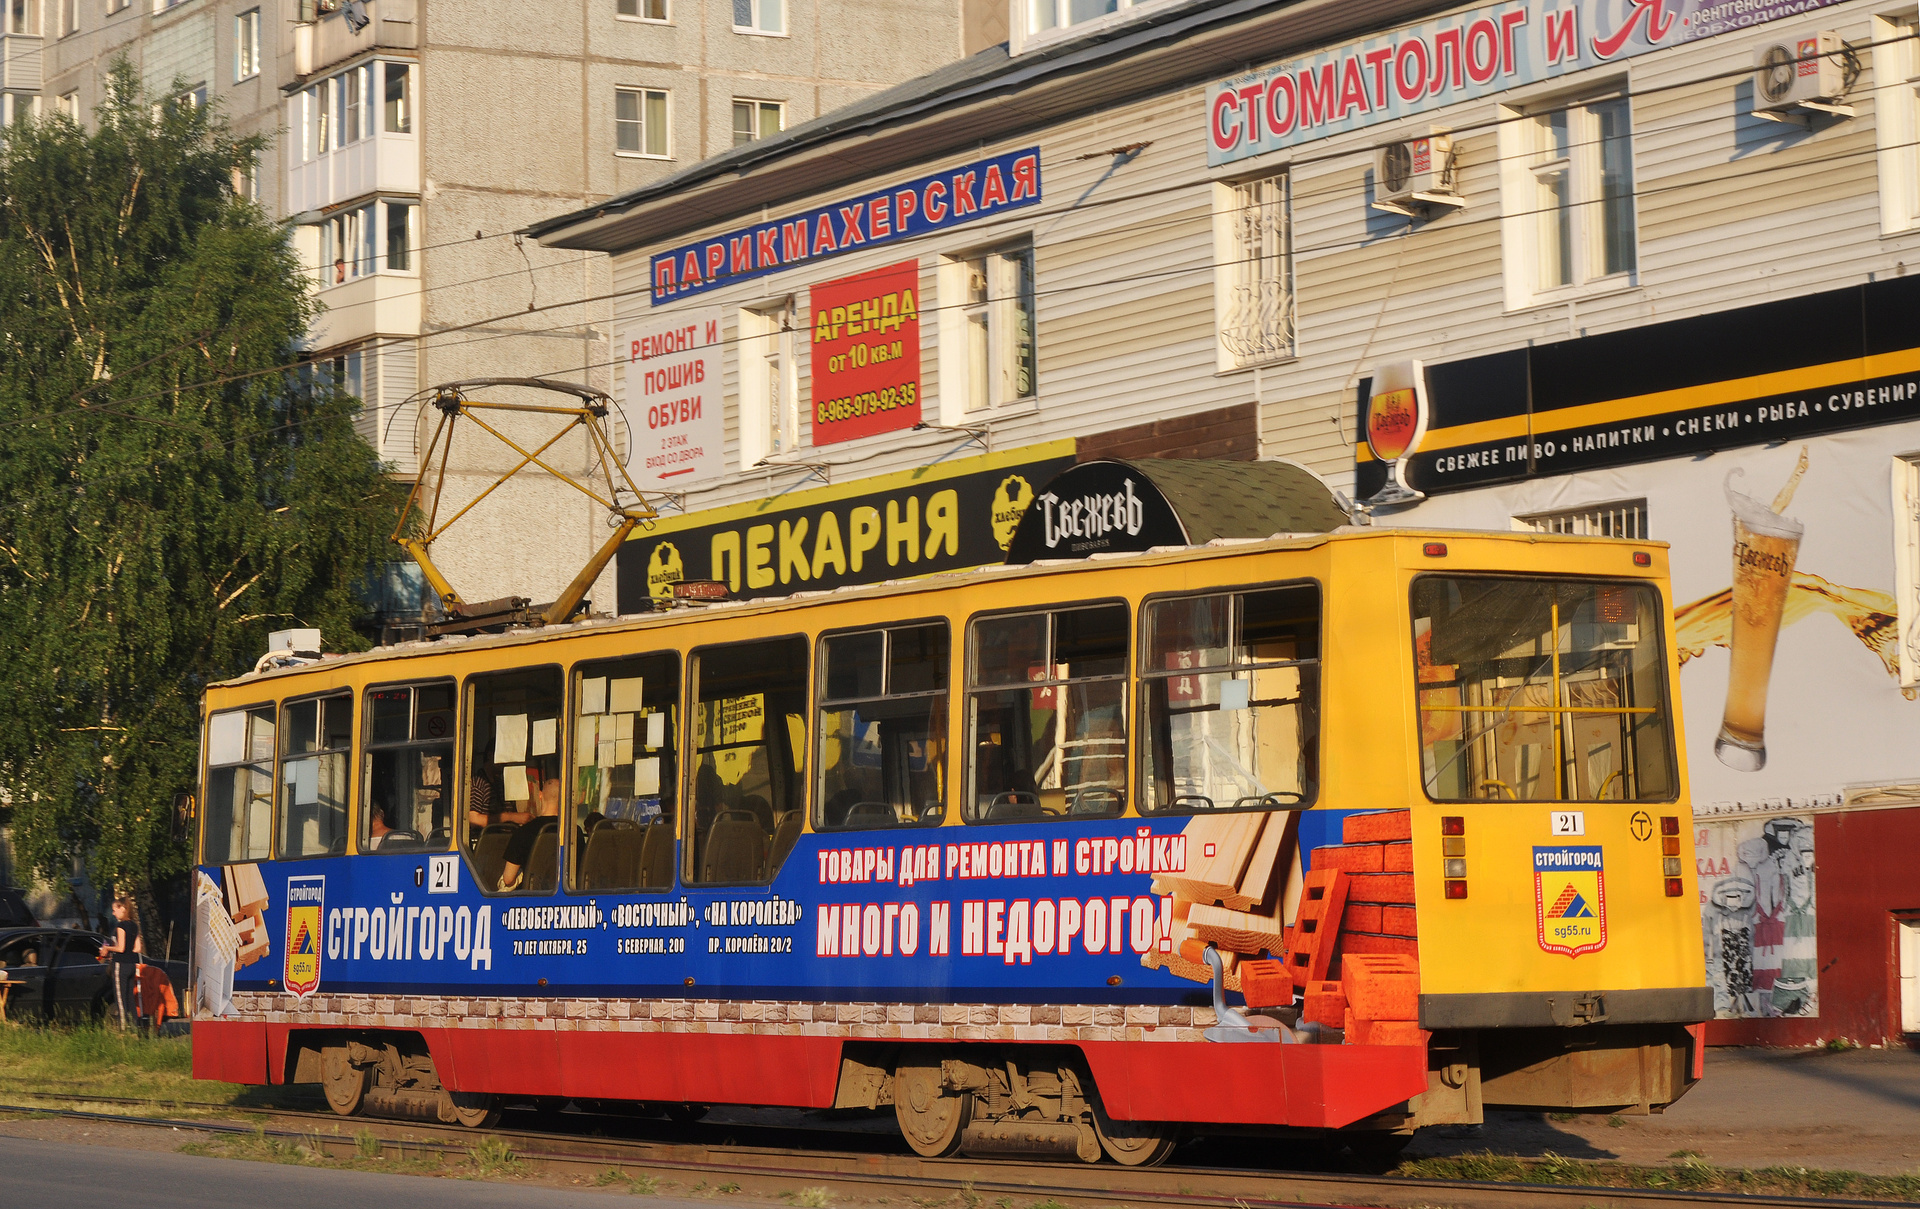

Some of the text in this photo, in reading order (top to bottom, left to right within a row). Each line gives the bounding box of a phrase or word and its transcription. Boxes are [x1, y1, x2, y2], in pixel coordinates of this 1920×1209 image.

[1212, 7, 1527, 151] СТОМАТОЛОГ
[654, 155, 1039, 297] ПАРИКМАХЕРСКАЯ
[814, 288, 917, 344] АРЕНДА
[631, 319, 717, 363] РЕМОНТ И
[848, 343, 868, 369] 10
[644, 359, 705, 395] ПОШИВ
[648, 395, 702, 430] ОБУВИ
[817, 381, 916, 424] 8-965-979-92-35
[661, 434, 688, 450] 2 ЭТАЖ
[1435, 381, 1920, 473] СВЕЖЕЕ ПИВО НАПИТКИ СНЕКИ РЫБА СУВЕНИР
[646, 446, 704, 469] ВХОД СО ДВОРА
[710, 488, 958, 593] ПЕКАРНЯ
[1560, 814, 1578, 832] 21
[817, 826, 1187, 886] ТОВАРЫ ДЛЯ РЕМОНТА И СТРОЙКИ
[1535, 849, 1601, 868] СТРОЙГОРОД
[434, 861, 451, 888] 21
[290, 884, 322, 902] СТРОЙГОРОД
[327, 892, 492, 971] СТРОЙГОРОД
[708, 934, 792, 953] ПР. КОРОЛЁВА 20/2
[816, 895, 1174, 965] МНОГО И НЕДОРОГО!
[1555, 925, 1591, 939] sg55.ru
[513, 938, 587, 957] 70 ЛЕТ ОКТЯБРЯ, 25
[618, 937, 685, 955] 5 СЕВЕРНАЯ, 200
[293, 961, 311, 975] sg55.ru
